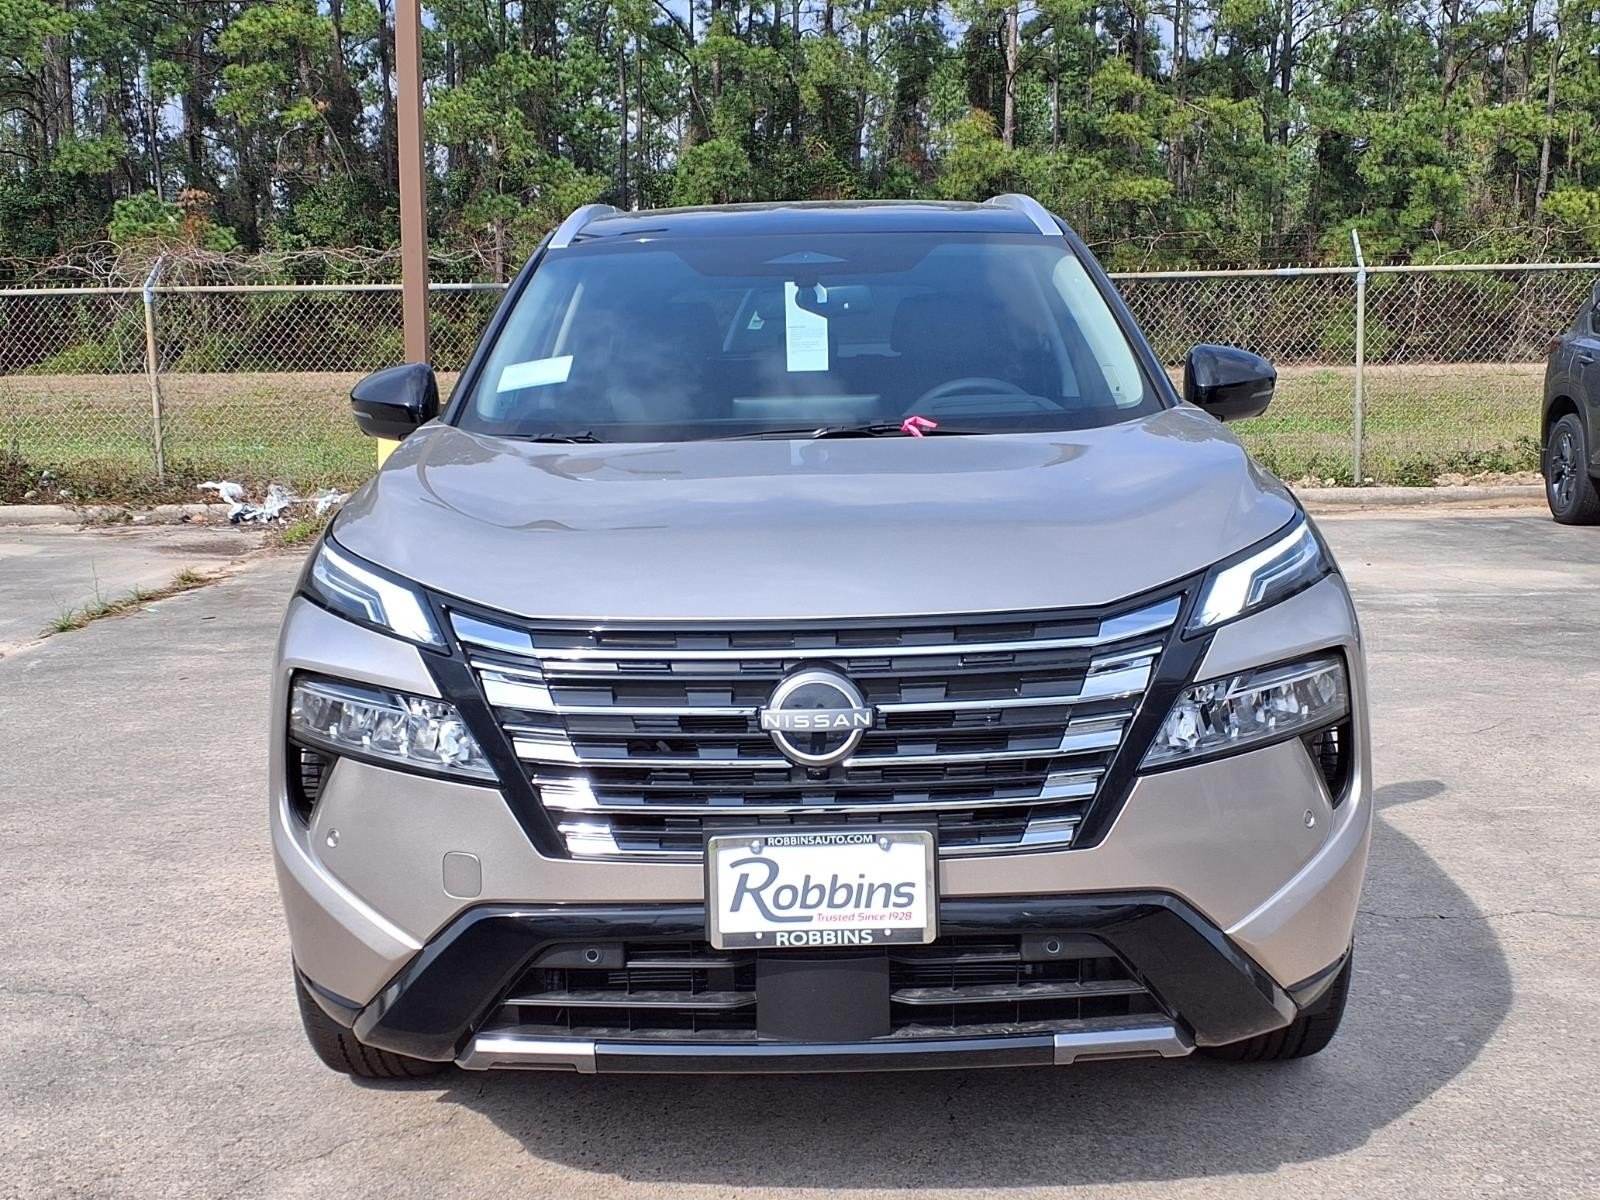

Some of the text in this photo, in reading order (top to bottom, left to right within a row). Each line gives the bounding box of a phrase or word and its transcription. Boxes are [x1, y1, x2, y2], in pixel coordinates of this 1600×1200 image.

[763, 712, 870, 728] NISSAN
[768, 834, 873, 847] ROBBINSAUTO.COM
[729, 857, 916, 922] Robbins
[816, 911, 912, 922] Trusted Since 1928
[776, 930, 873, 945] ROBBINS
